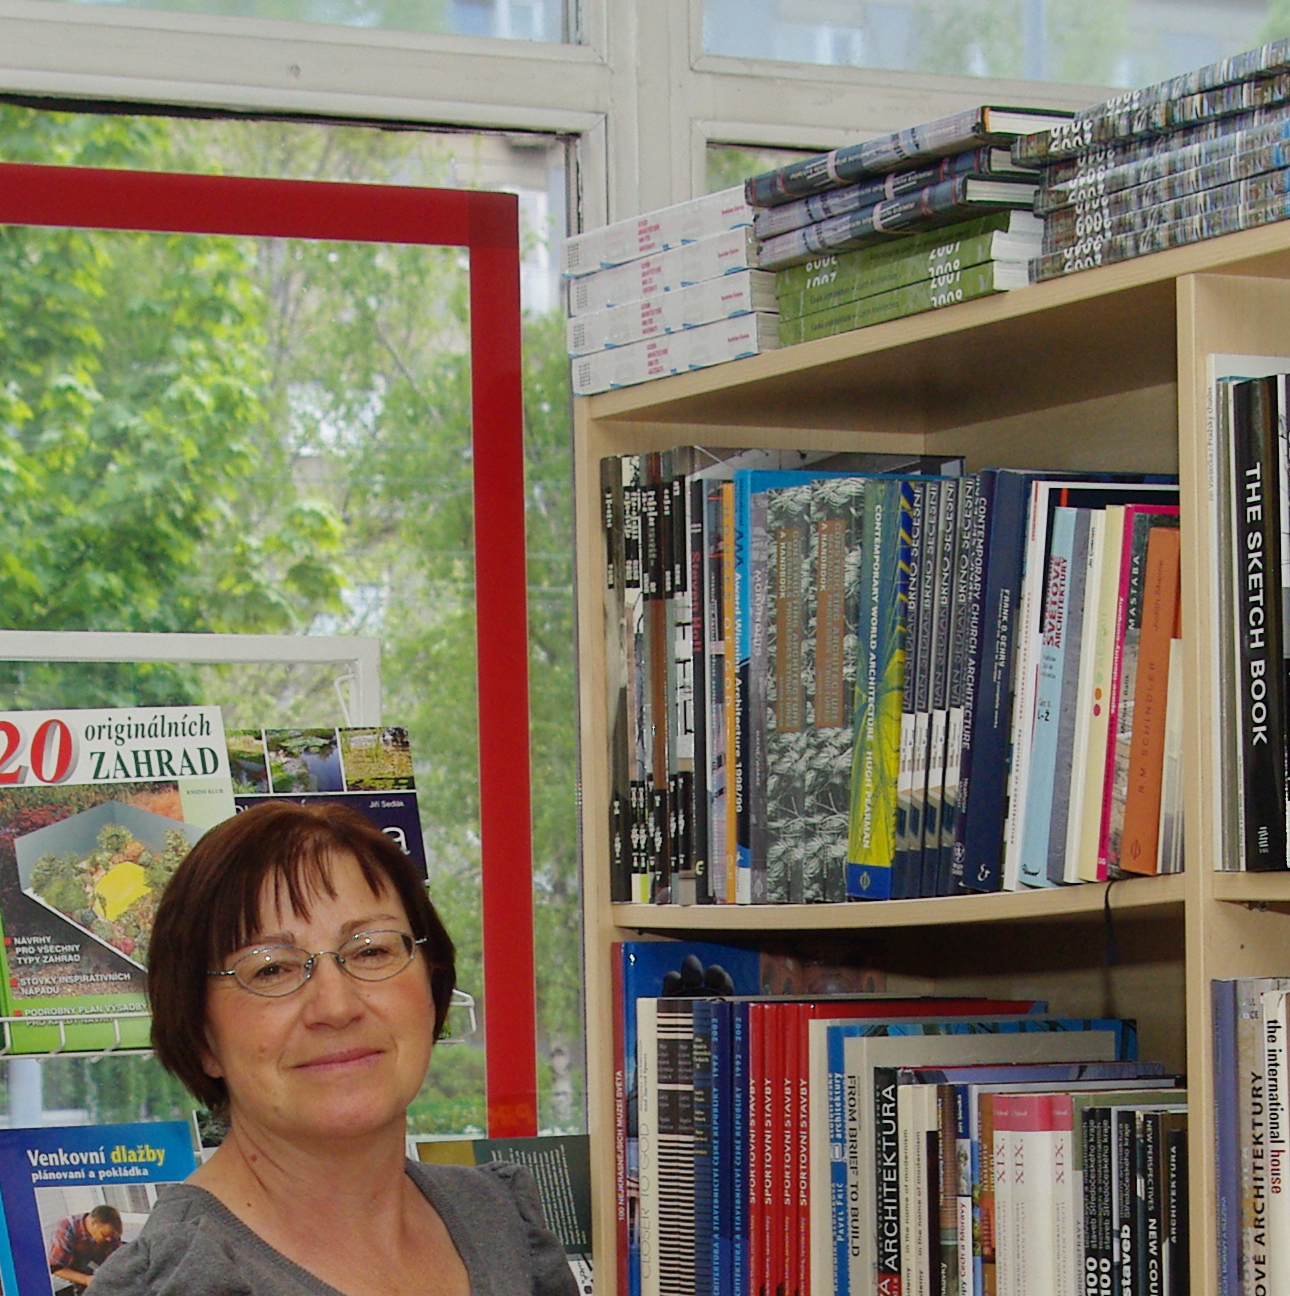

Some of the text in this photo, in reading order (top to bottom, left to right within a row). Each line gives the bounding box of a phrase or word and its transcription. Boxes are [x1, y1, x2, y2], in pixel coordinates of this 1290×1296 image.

[1128, 555, 1140, 630] MASTABA
[1245, 462, 1268, 746] THE SKETCH BOOK
[85, 713, 212, 745] originálních
[863, 504, 883, 850] CONTEMPORARY WORLD ARCHITECTURE HUGH PEARMAN
[89, 747, 219, 780] ZAHRAD
[27, 1145, 165, 1167] Venkovní dlažby
[1251, 1070, 1267, 1243] ARCHITEKTURY
[1267, 1019, 1285, 1194] the international house
[882, 1084, 898, 1271] ARCHITEKTURA
[1148, 1218, 1157, 1255] NEW
